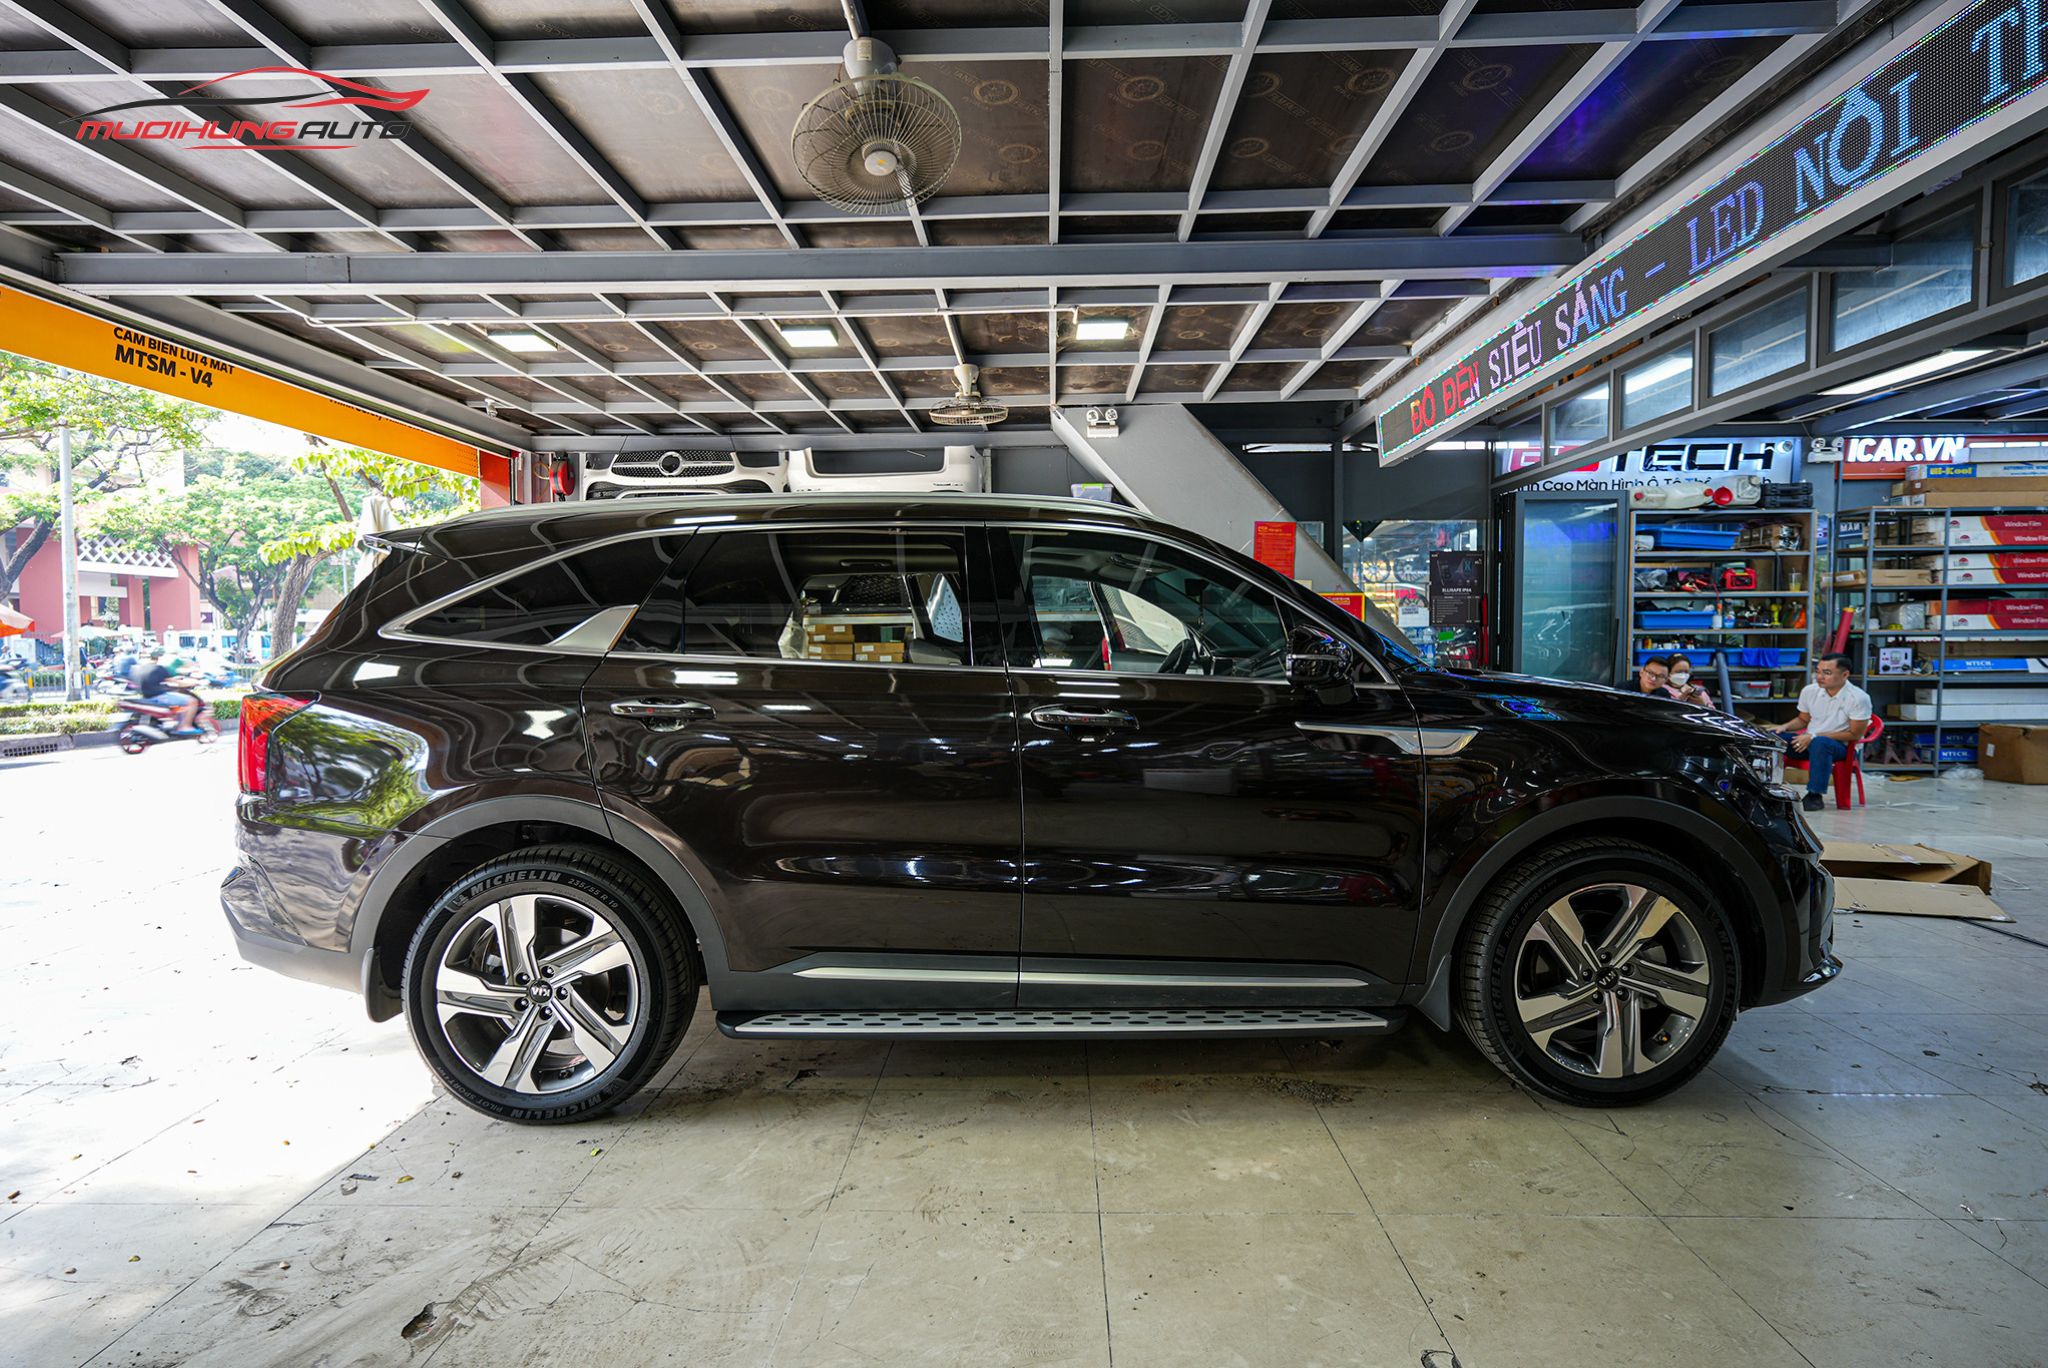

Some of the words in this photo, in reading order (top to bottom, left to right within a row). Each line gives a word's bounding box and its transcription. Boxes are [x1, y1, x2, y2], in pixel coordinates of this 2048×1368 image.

[1488, 319, 1542, 390] SIÊU
[1555, 266, 1628, 351] SÁNG
[1687, 181, 1764, 275] LED
[115, 344, 176, 377] MTSM
[190, 366, 213, 388] V4
[200, 356, 208, 366] 4
[1847, 436, 1966, 463] ICAR.VN
[1542, 480, 1574, 491] Cao
[1576, 478, 1608, 491] Màn
[470, 870, 561, 895] MICHELIN
[568, 878, 600, 895] 235/55
[1490, 945, 1511, 1034] MICHELIN
[510, 1093, 605, 1120] MICHELIN
